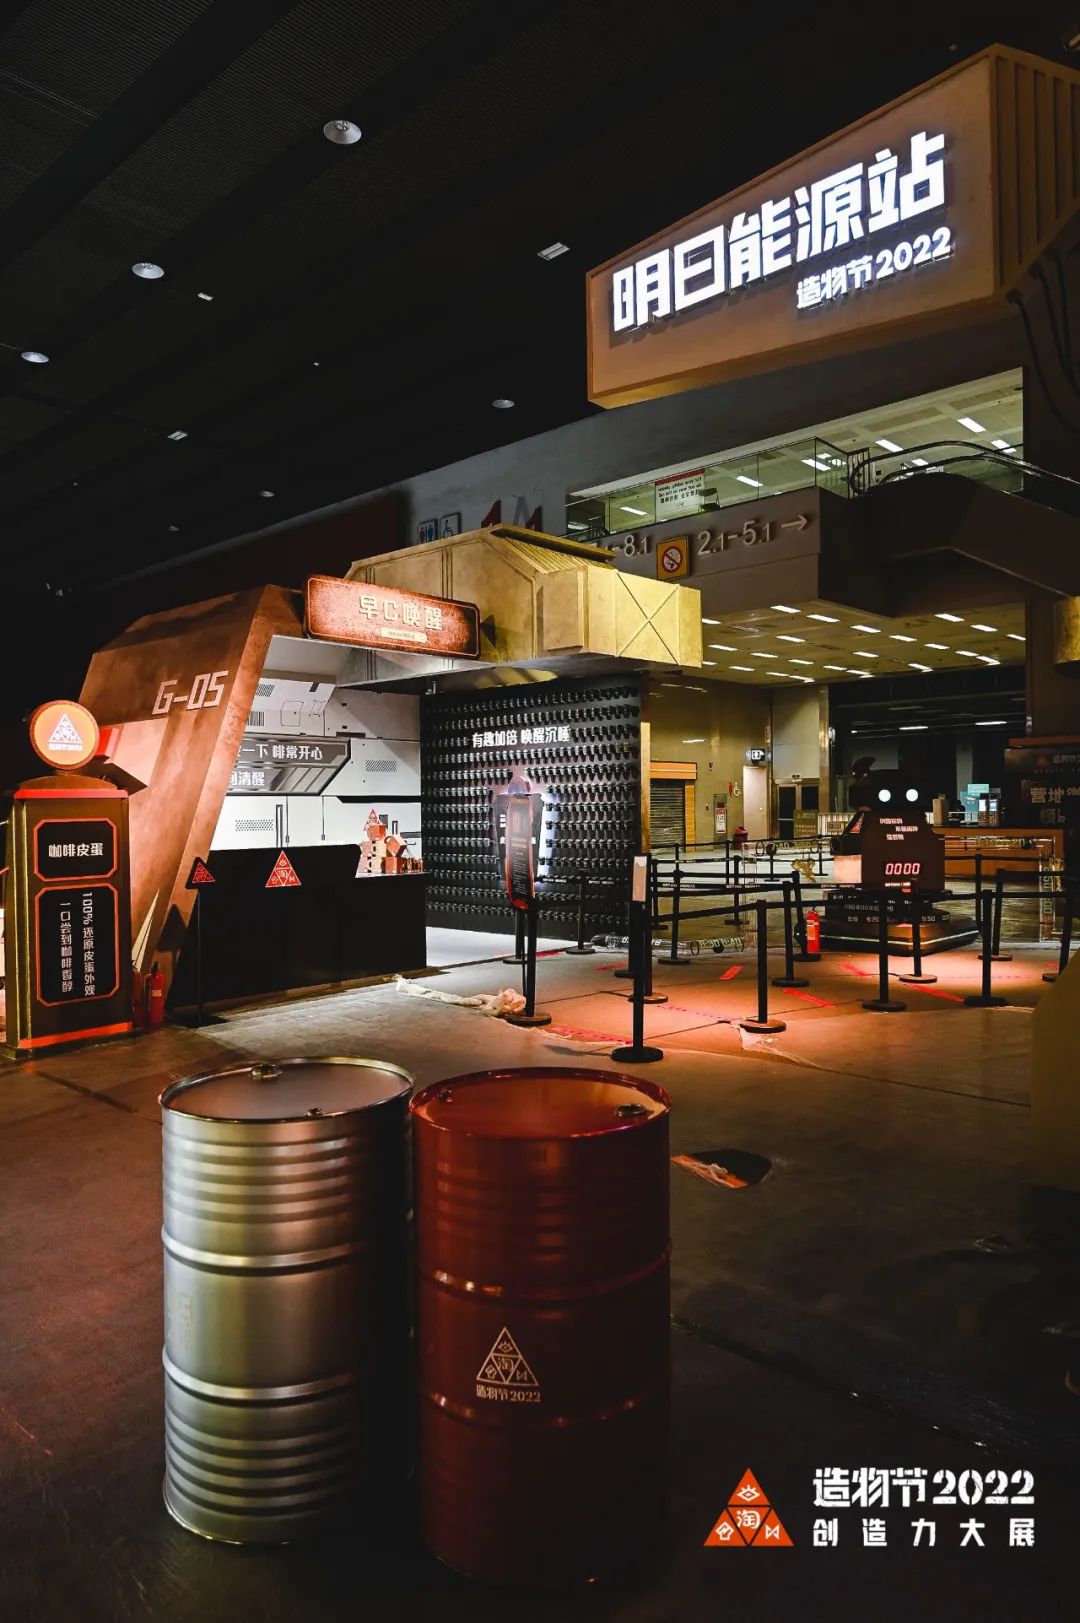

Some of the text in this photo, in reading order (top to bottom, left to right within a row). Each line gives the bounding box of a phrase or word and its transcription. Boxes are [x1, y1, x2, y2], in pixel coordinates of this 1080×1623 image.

[613, 131, 945, 331] 明日能源站
[796, 226, 953, 310] 造物节2022
[698, 519, 771, 555] 2.1-5.1
[473, 730, 518, 748] 有趣加倍
[237, 744, 323, 760] 一下 啡常开心
[48, 842, 104, 858] 咖啡皮蛋
[885, 863, 920, 876] 0000
[476, 1383, 542, 1403] 造物节2022
